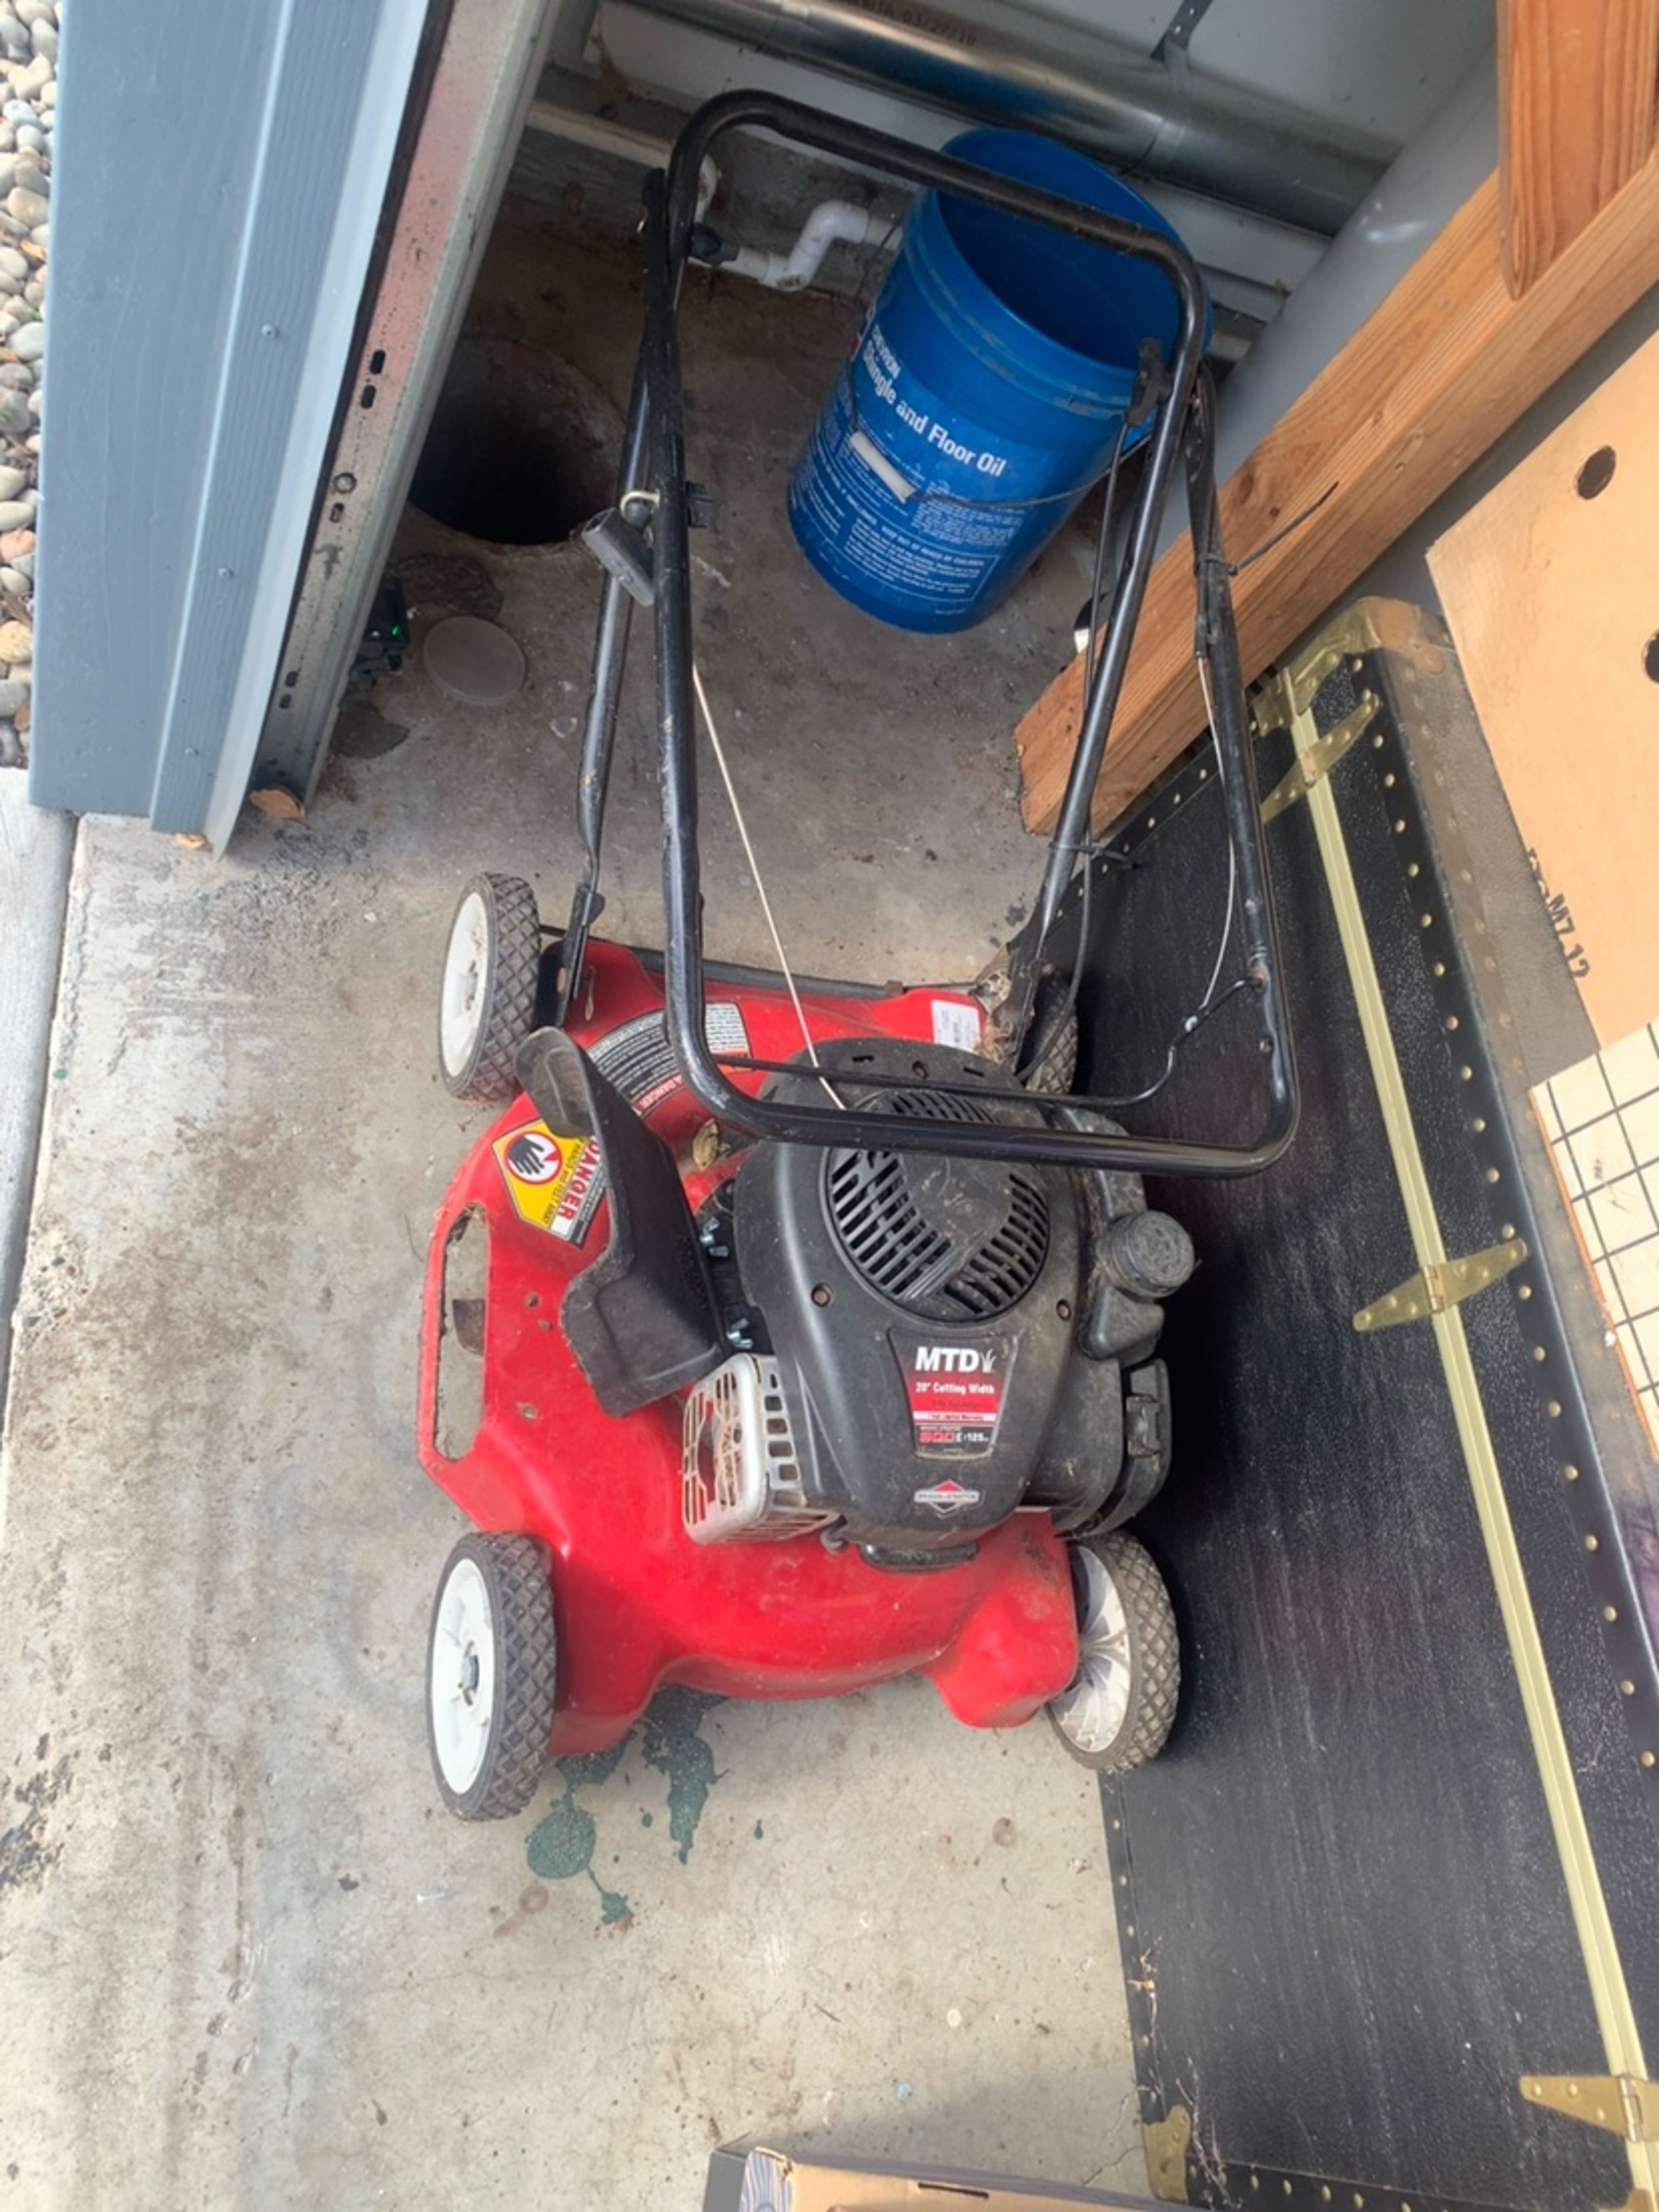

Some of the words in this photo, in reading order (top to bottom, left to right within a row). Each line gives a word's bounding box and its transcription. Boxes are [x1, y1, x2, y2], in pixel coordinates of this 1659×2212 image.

[863, 340, 897, 405] Shingle
[896, 400, 929, 434] and
[928, 423, 977, 465] Floor
[977, 451, 1007, 477] Oil
[558, 1138, 600, 1220] DANGER
[915, 1346, 980, 1372] MTD
[933, 1382, 966, 1395] Cutting
[968, 1384, 995, 1394] Width
